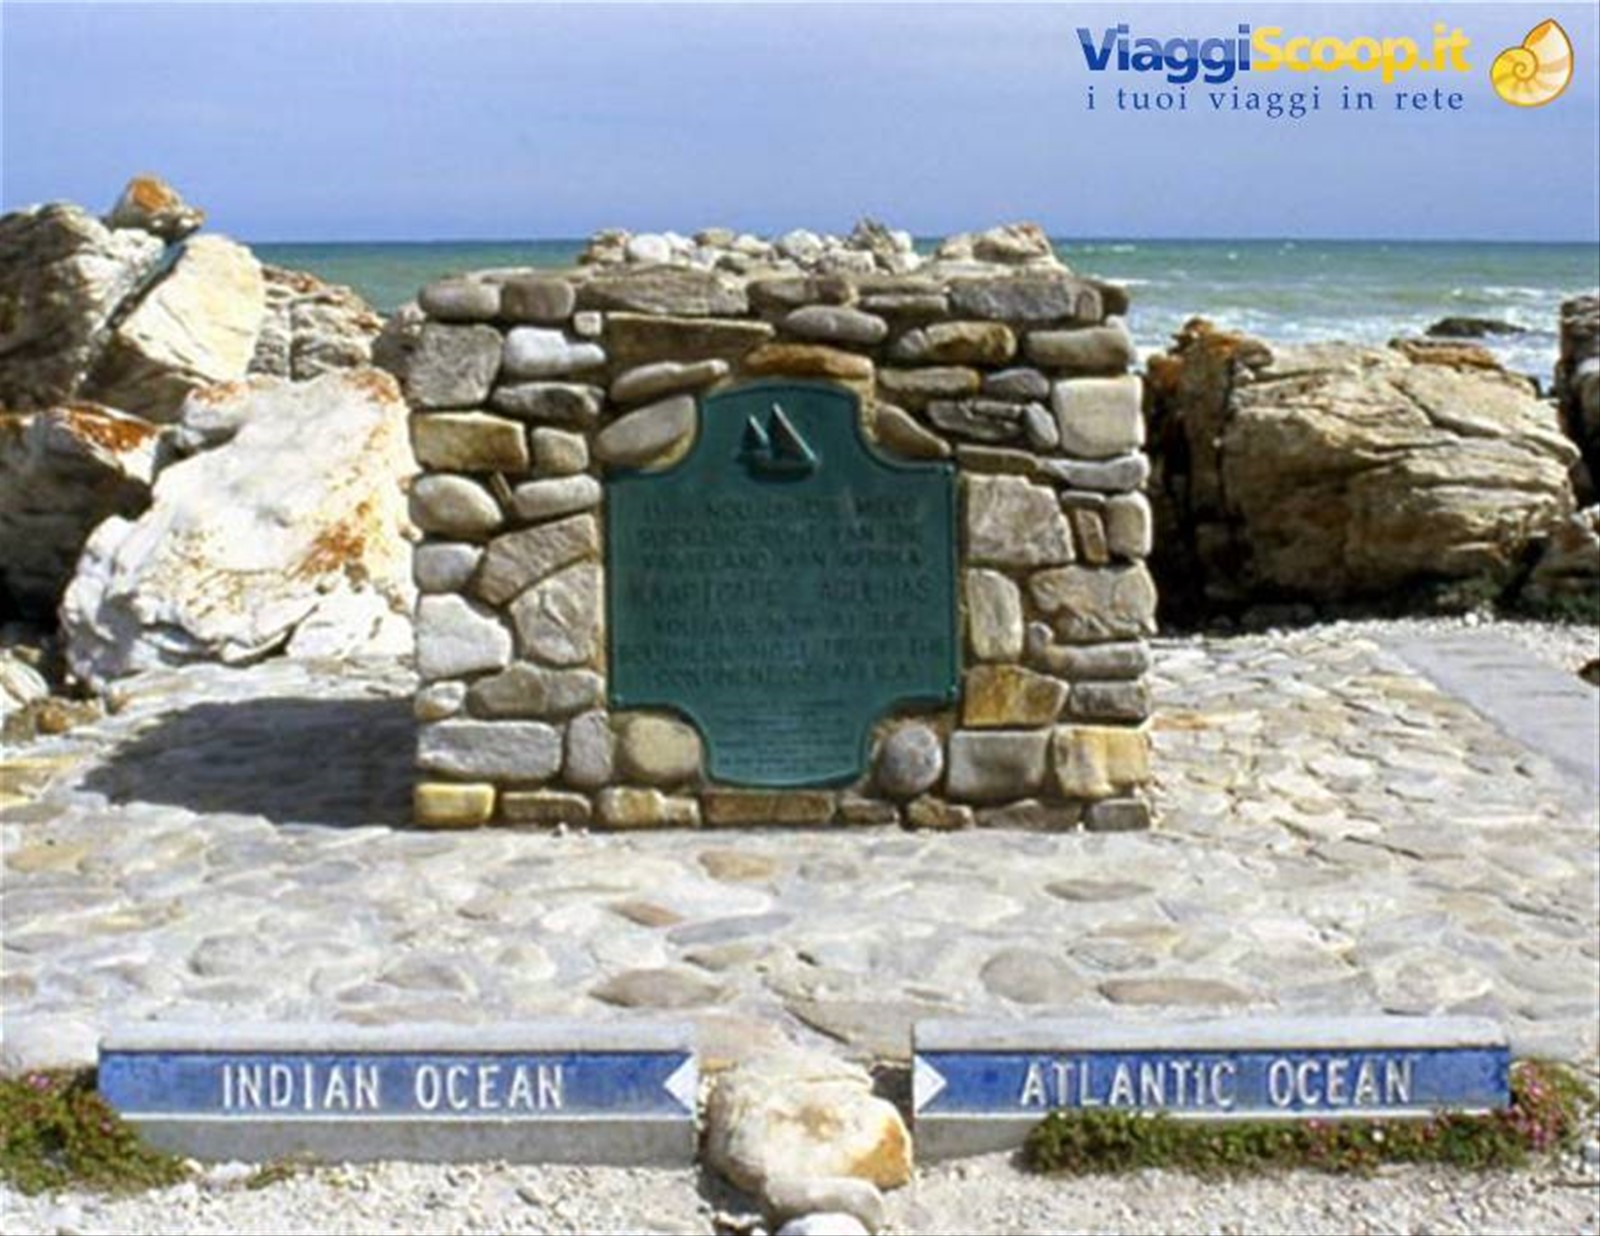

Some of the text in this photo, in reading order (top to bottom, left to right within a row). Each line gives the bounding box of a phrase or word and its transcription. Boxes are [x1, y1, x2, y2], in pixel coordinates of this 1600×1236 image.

[222, 1064, 565, 1111] INDIAN OCEAN
[1020, 1058, 1415, 1106] ATLANTIC OCEAN
